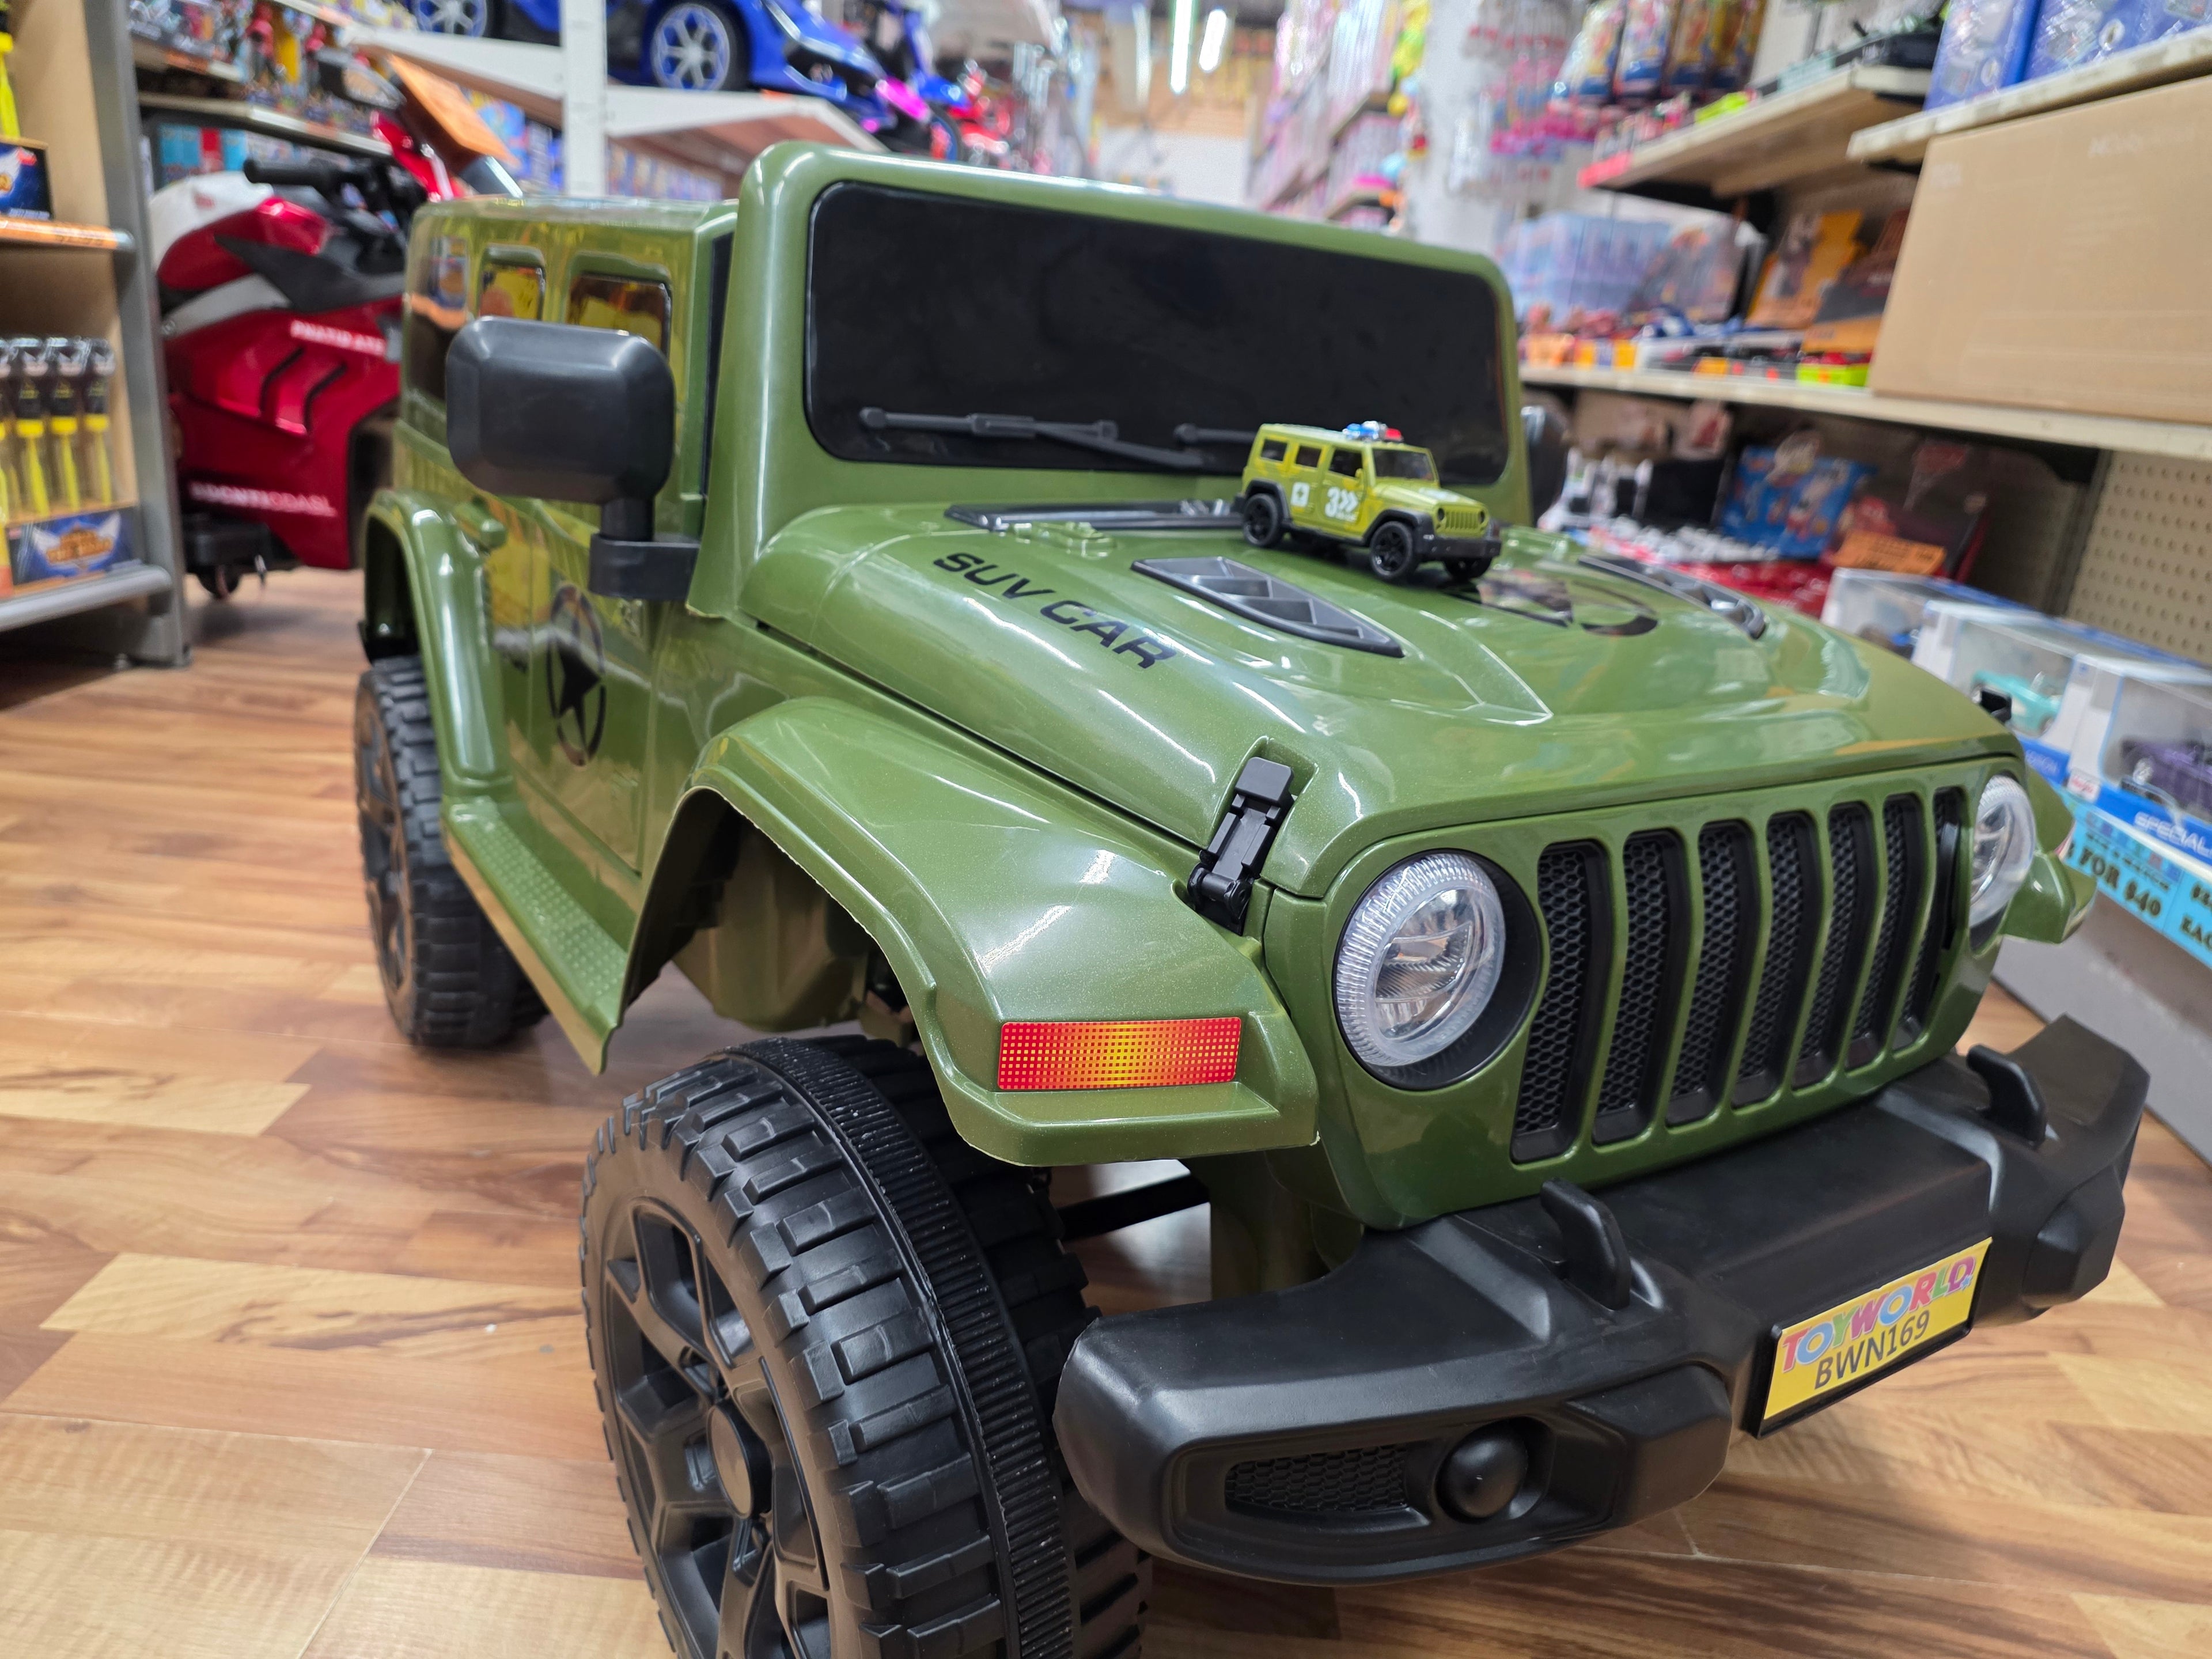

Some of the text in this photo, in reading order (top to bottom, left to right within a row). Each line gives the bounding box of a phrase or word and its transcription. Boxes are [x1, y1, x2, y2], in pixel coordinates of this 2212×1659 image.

[933, 552, 1176, 669] SUV CAR
[2080, 846, 2120, 889] FOR
[1782, 1255, 1977, 1373] TOYWORLD
[1814, 1309, 1930, 1390] BWN169
